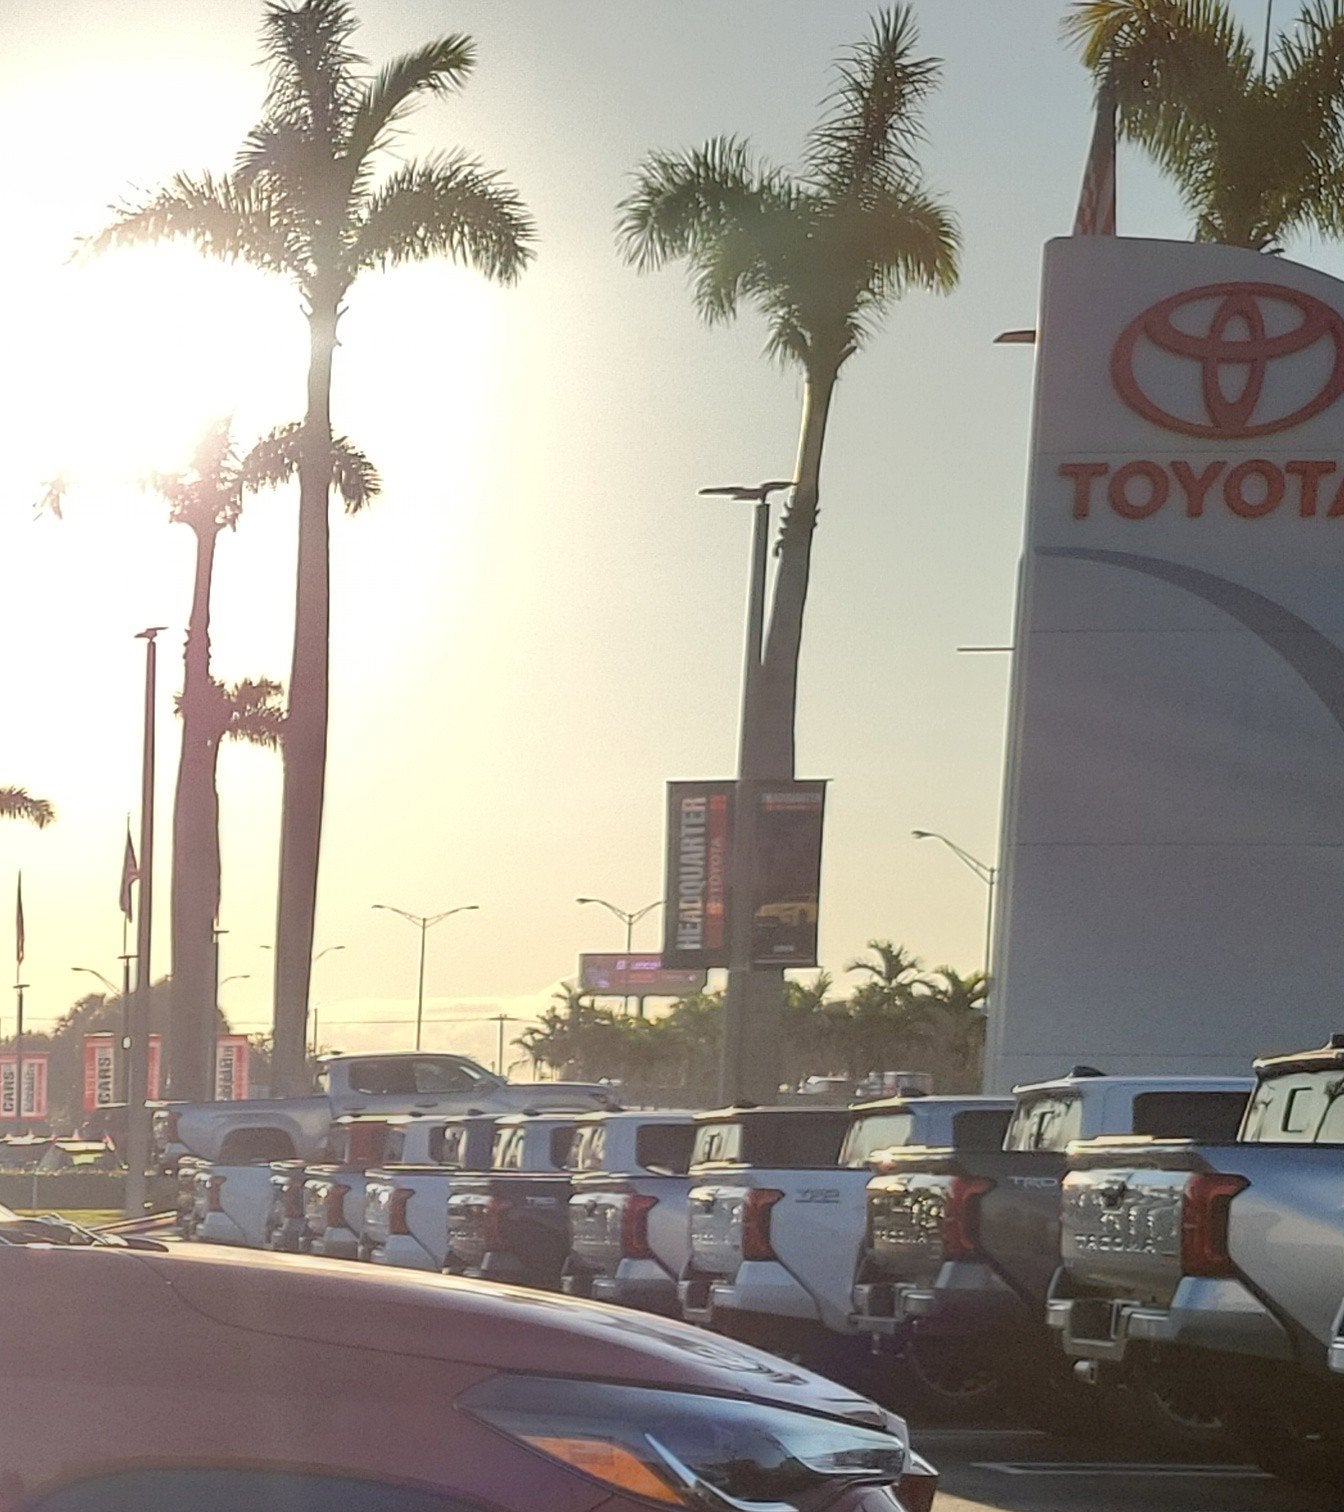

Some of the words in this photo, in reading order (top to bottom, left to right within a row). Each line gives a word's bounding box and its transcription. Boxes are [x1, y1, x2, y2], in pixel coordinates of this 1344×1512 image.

[675, 798, 706, 950] HEADQUARTER
[97, 1057, 112, 1104] CARS
[1008, 1175, 1058, 1189] TRD
